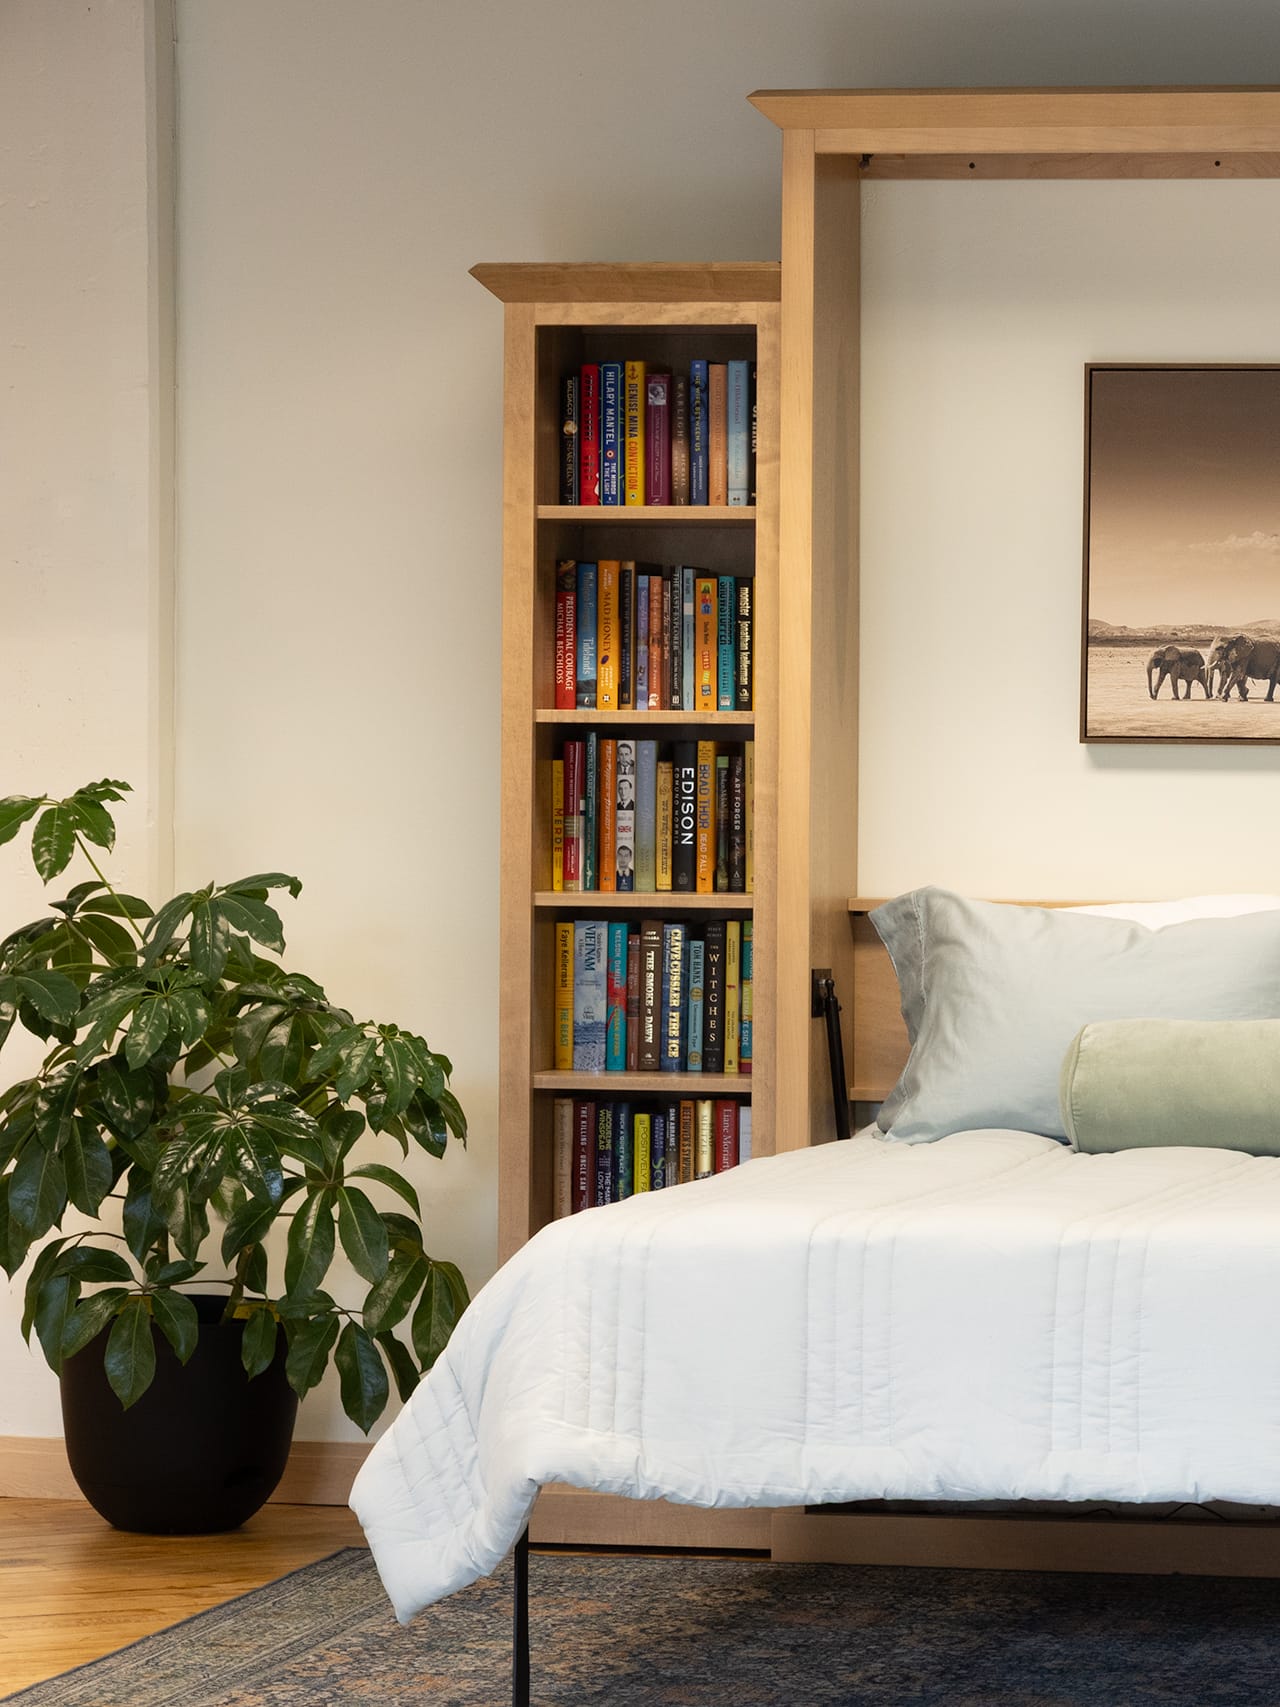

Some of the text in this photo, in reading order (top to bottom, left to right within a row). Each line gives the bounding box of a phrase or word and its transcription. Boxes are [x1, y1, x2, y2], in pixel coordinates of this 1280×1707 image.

[606, 371, 616, 446] HILARY MANTEL
[676, 382, 685, 448] WARLIGHT
[628, 383, 639, 491] DENISE MINA CONVICTION
[695, 442, 701, 453] US
[603, 590, 611, 654] MAD HONEY
[740, 587, 751, 617] monster
[556, 641, 564, 684] BESCHLOSS
[565, 596, 574, 691] PRESIDENTIAL COURAGE
[582, 637, 594, 675] Tidelands
[739, 620, 751, 686] jonathan kellerman
[586, 770, 594, 798] MARKET
[699, 764, 711, 796] BRAD
[734, 778, 742, 793] ART
[681, 767, 695, 846] EDISON
[698, 799, 711, 830] THOR
[554, 807, 563, 853] MERDE
[699, 833, 707, 875] DEAD FALL
[561, 929, 570, 988] Faye Kellerman
[585, 925, 596, 971] VIETNAM
[614, 929, 622, 958] NELSON
[692, 945, 702, 985] TOM HANKS
[645, 950, 655, 1044] THE SMOKE DAWN
[667, 928, 682, 1058] CLIVE CUSSLER FIRE ICE
[709, 953, 720, 1042] WITCHES
[560, 1008, 569, 1047] THE BEAST
[580, 1106, 588, 1118] THE
[598, 1109, 606, 1150] WINSPEAR
[605, 1109, 613, 1150] JACQUELINE
[723, 1108, 732, 1133] Liane
[580, 1120, 588, 1146] KILLING
[641, 1126, 649, 1179] POSITIVELY
[580, 1154, 588, 1175] UNCLE
